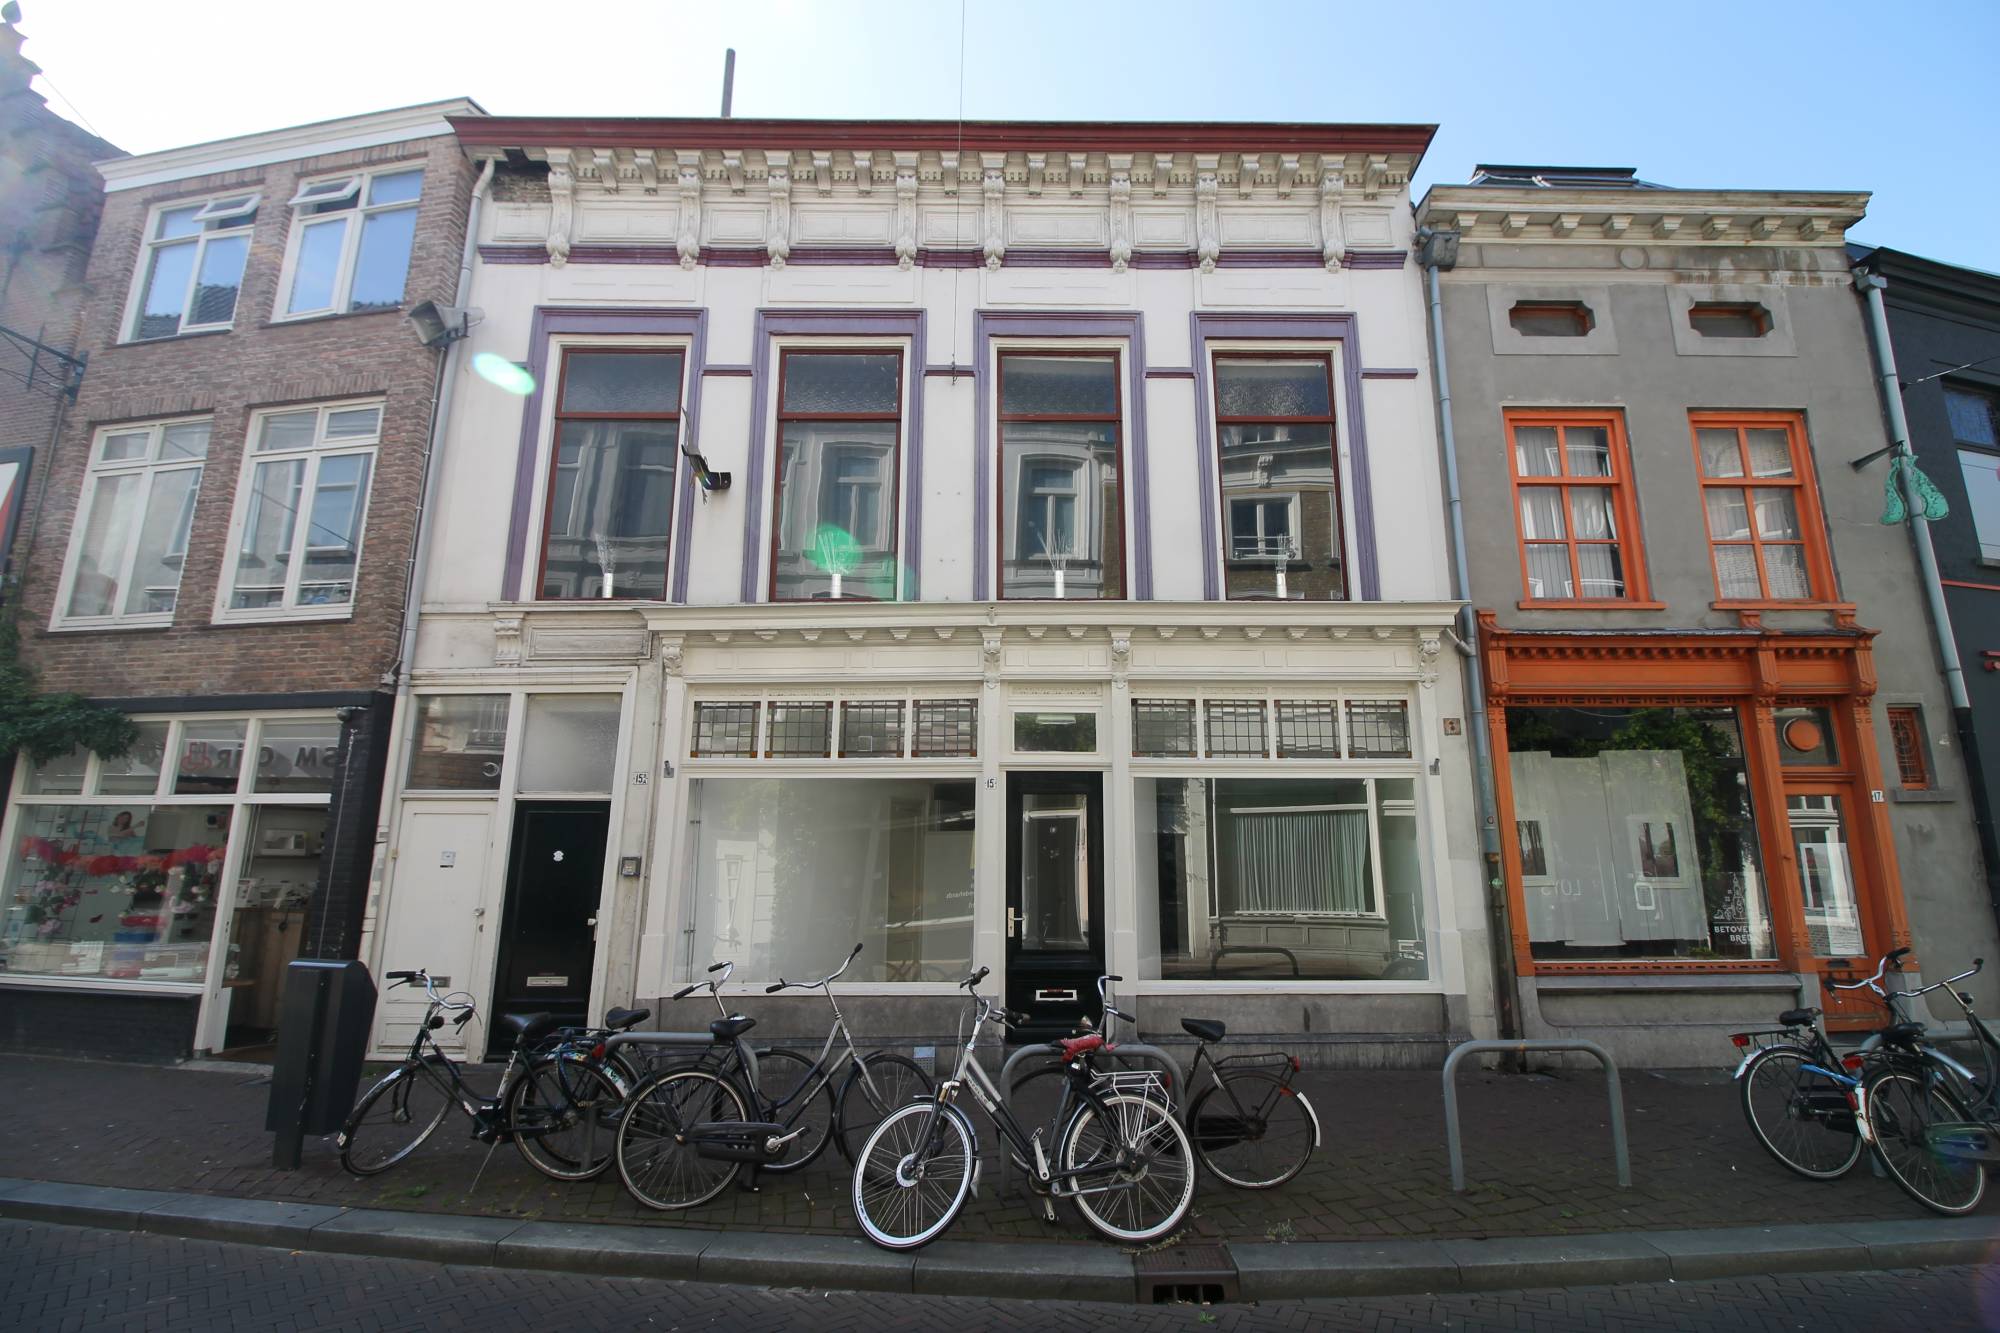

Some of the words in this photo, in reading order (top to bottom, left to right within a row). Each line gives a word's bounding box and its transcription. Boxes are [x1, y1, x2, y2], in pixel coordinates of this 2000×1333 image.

[986, 778, 995, 788] 15
[1873, 791, 1881, 801] 17
[1714, 925, 1772, 933] BETOVED
